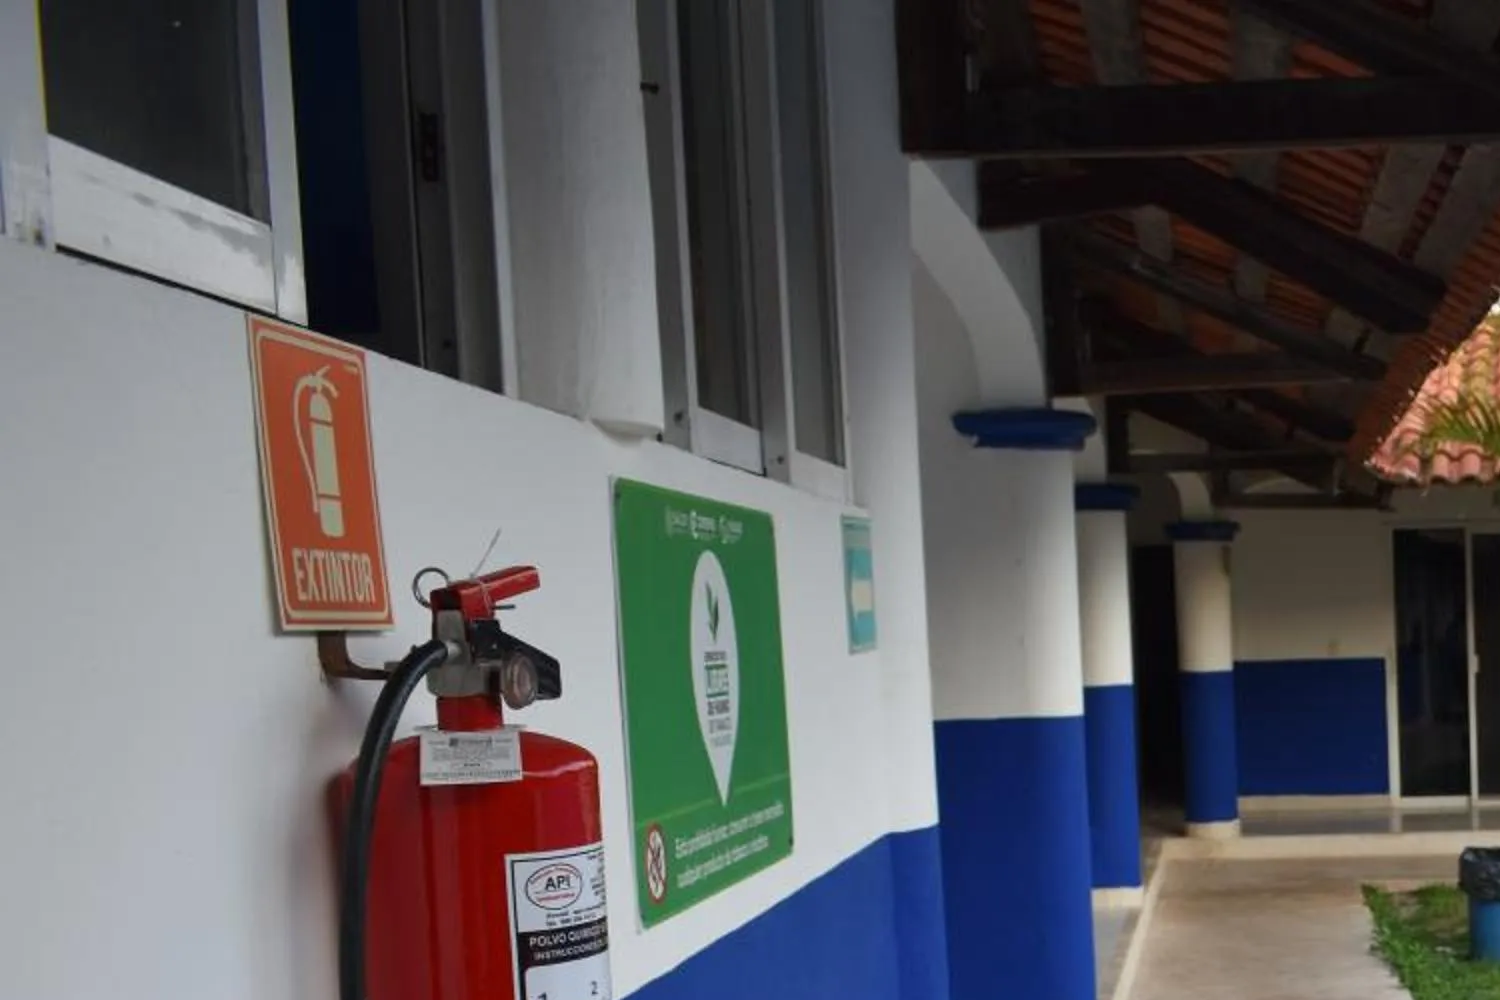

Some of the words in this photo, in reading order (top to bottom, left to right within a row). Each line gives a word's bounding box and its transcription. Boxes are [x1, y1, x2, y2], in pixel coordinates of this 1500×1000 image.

[291, 547, 377, 605] EXTINTOR
[544, 874, 571, 892] API
[529, 932, 566, 948] POLVO
[591, 981, 599, 996] 2
